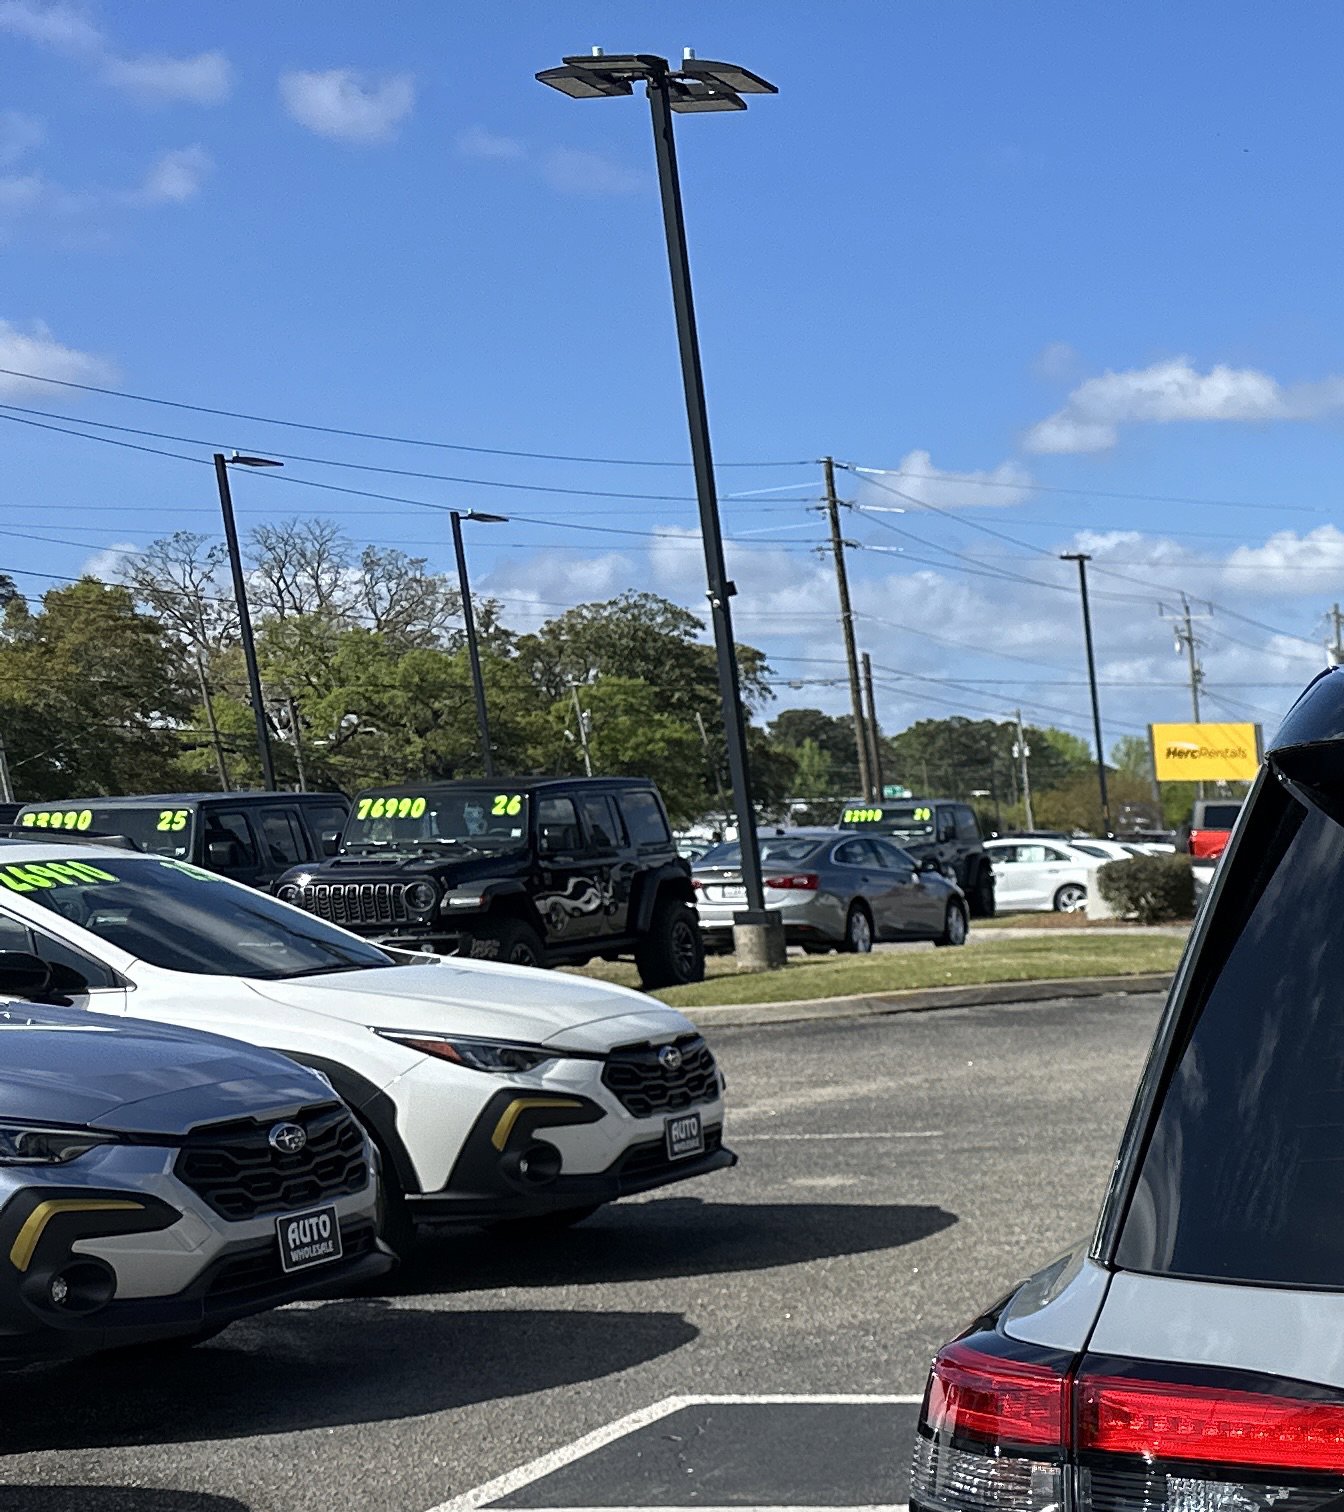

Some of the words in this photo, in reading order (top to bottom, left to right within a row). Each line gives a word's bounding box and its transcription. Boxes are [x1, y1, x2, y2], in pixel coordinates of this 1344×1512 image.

[357, 797, 426, 820] 76990
[491, 794, 522, 816] 26
[157, 810, 188, 831] 25
[672, 1117, 698, 1142] AUTO
[287, 1214, 331, 1249] AUTO
[290, 1240, 334, 1262] WHOLESALE
